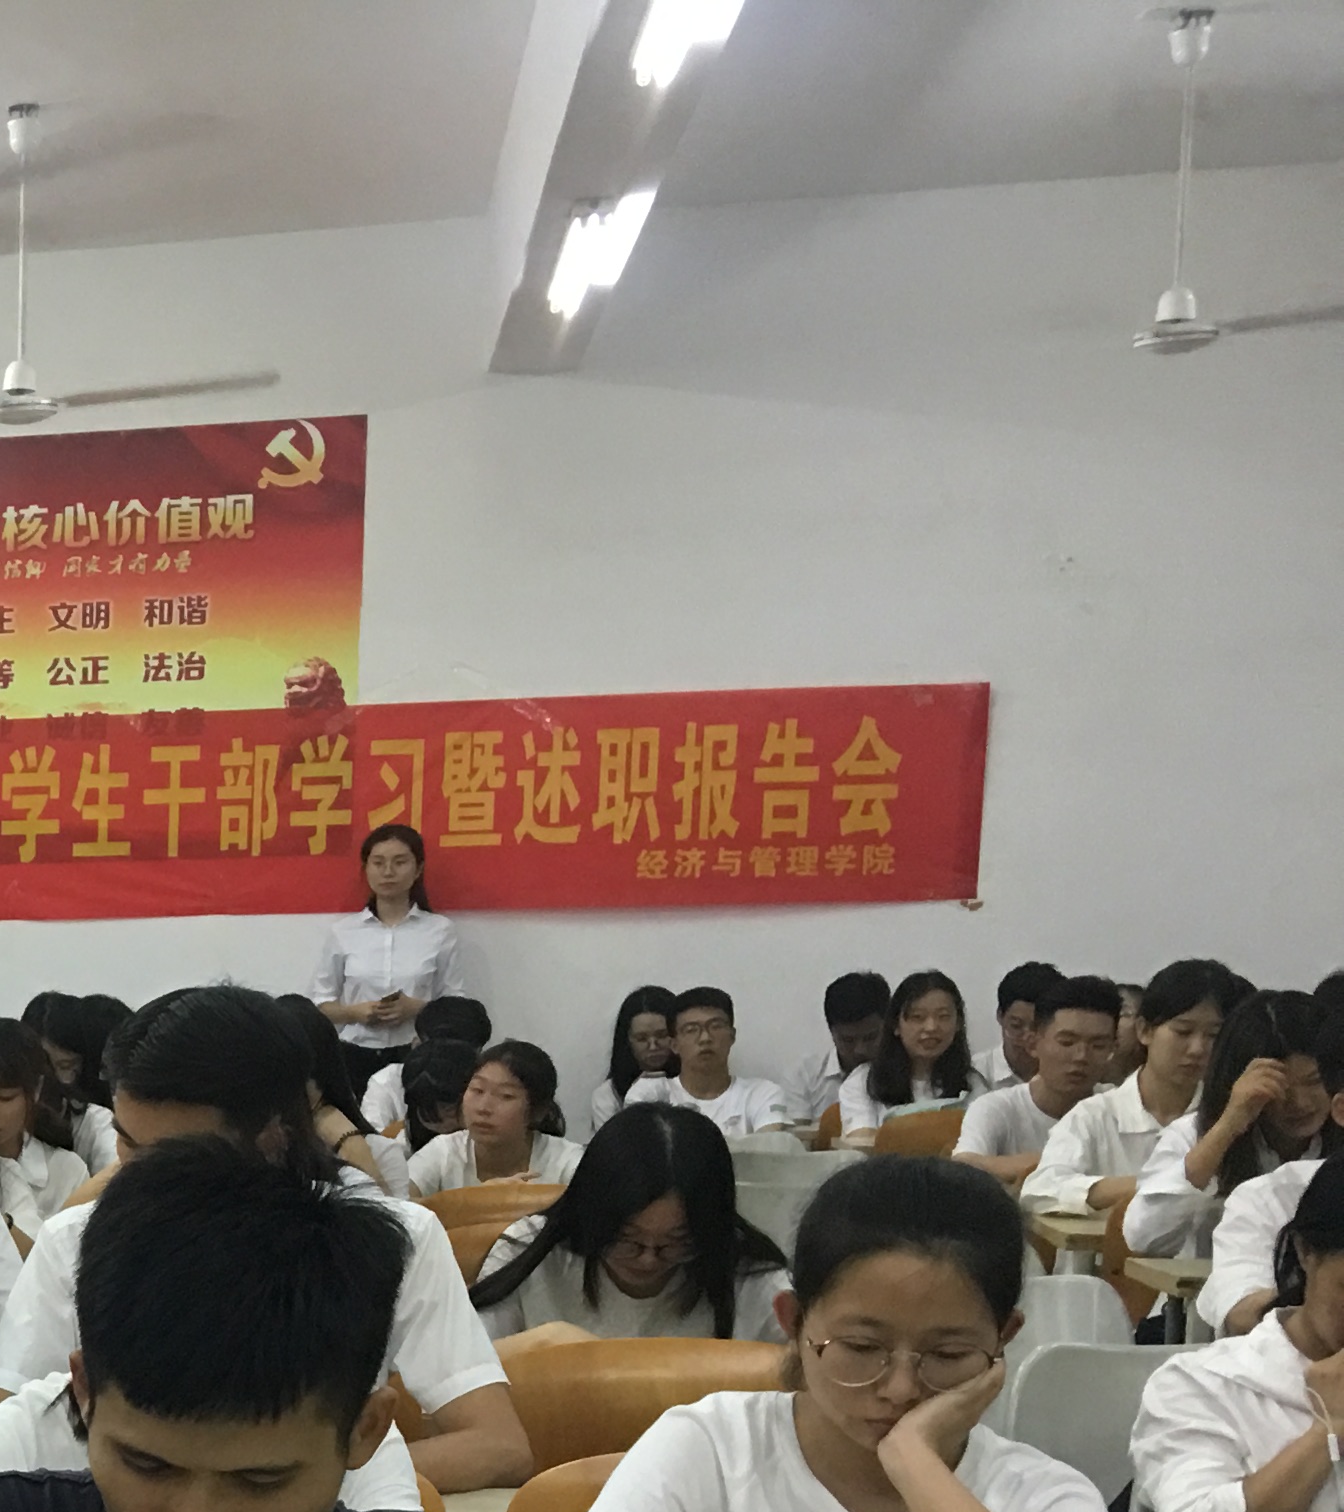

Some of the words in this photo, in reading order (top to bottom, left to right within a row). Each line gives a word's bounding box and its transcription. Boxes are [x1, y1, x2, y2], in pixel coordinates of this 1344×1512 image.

[48, 599, 111, 631] 文明
[143, 594, 209, 627] 和谐
[46, 655, 110, 687] 公正
[142, 651, 207, 683] 法治
[635, 843, 897, 881] 经济与管理学院
